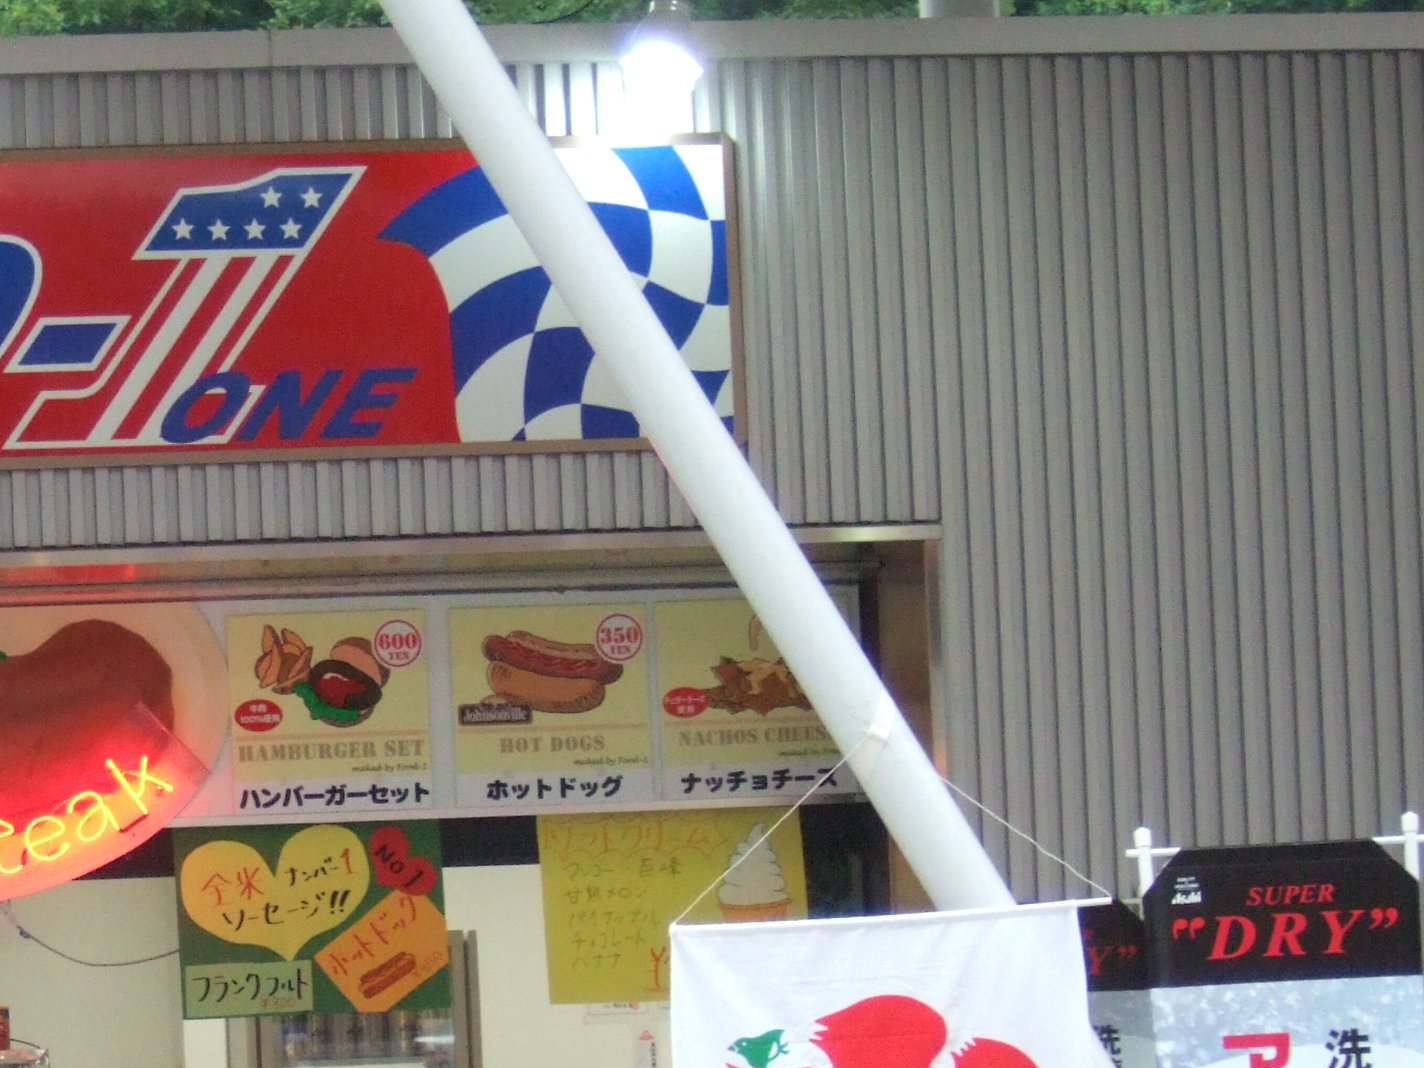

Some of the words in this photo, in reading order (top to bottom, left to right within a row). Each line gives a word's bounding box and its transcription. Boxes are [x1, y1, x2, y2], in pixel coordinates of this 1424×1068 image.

[160, 365, 417, 445] ONE
[378, 633, 417, 650] 600
[600, 626, 639, 645] 350
[499, 736, 542, 754] HOT
[550, 735, 606, 753] DOGS
[679, 728, 759, 747] NACHOS
[237, 741, 377, 763] HAMBURGER
[384, 739, 425, 758] SET
[239, 781, 430, 810] ハンバーガーセット
[486, 774, 624, 801] ホットドッグ
[1245, 882, 1336, 907] SUPER
[191, 967, 310, 1004] フランクフルト
